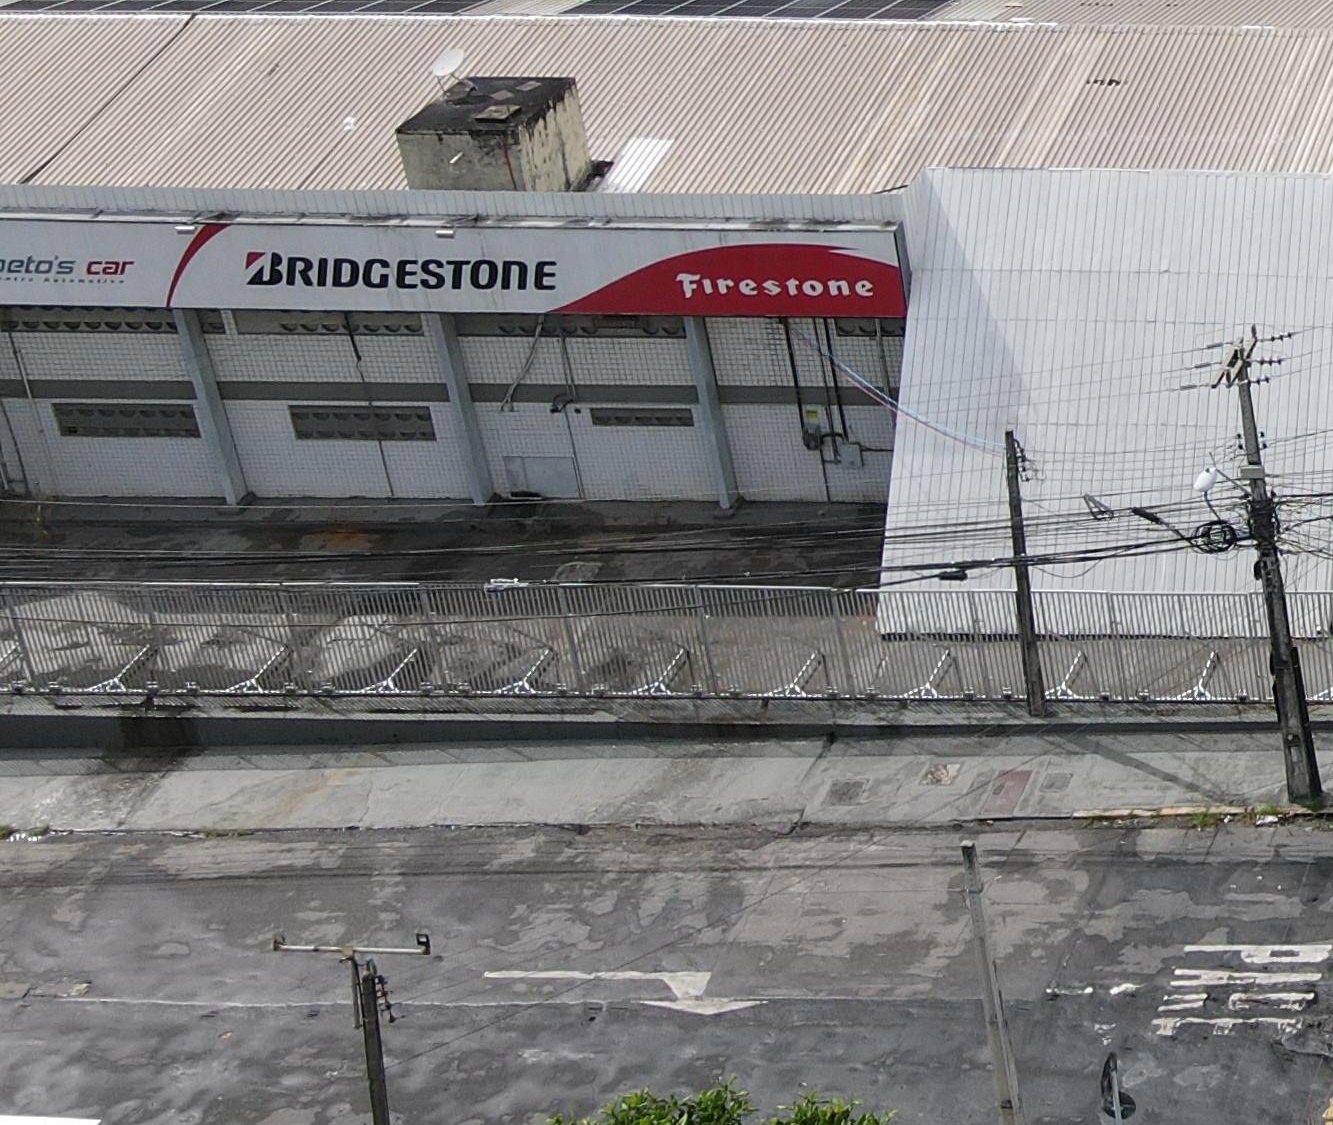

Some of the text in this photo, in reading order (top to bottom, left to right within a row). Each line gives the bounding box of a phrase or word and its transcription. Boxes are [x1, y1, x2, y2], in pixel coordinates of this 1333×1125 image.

[86, 260, 135, 276] car
[246, 251, 557, 292] BRIDGESTONE
[675, 271, 875, 301] Firestone
